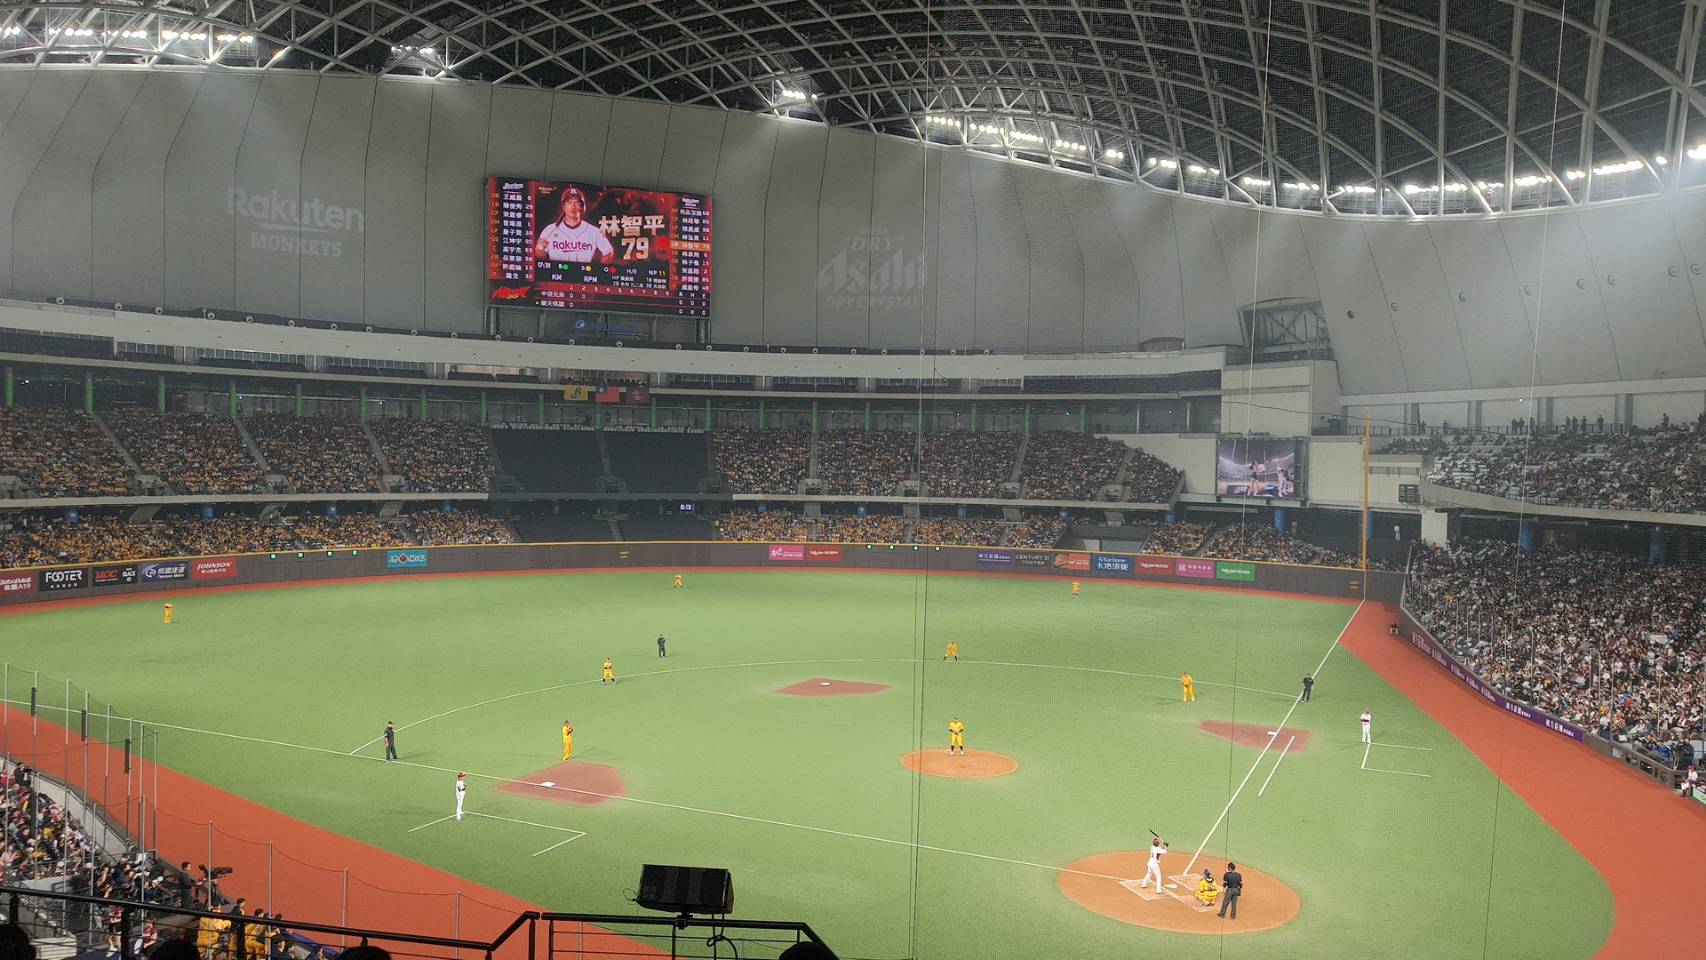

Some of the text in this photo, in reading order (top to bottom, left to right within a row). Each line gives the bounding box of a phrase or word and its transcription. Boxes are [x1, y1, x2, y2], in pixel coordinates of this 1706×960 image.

[227, 187, 365, 231] Rakuten
[599, 215, 665, 237] 林智平
[250, 231, 342, 257] MONKEYS
[553, 240, 592, 250] Rakuten
[622, 237, 649, 260] 79
[814, 247, 926, 293] Asahi
[45, 570, 82, 582] FOOTER
[96, 570, 119, 579] UCC
[197, 561, 231, 570] JOHNSON
